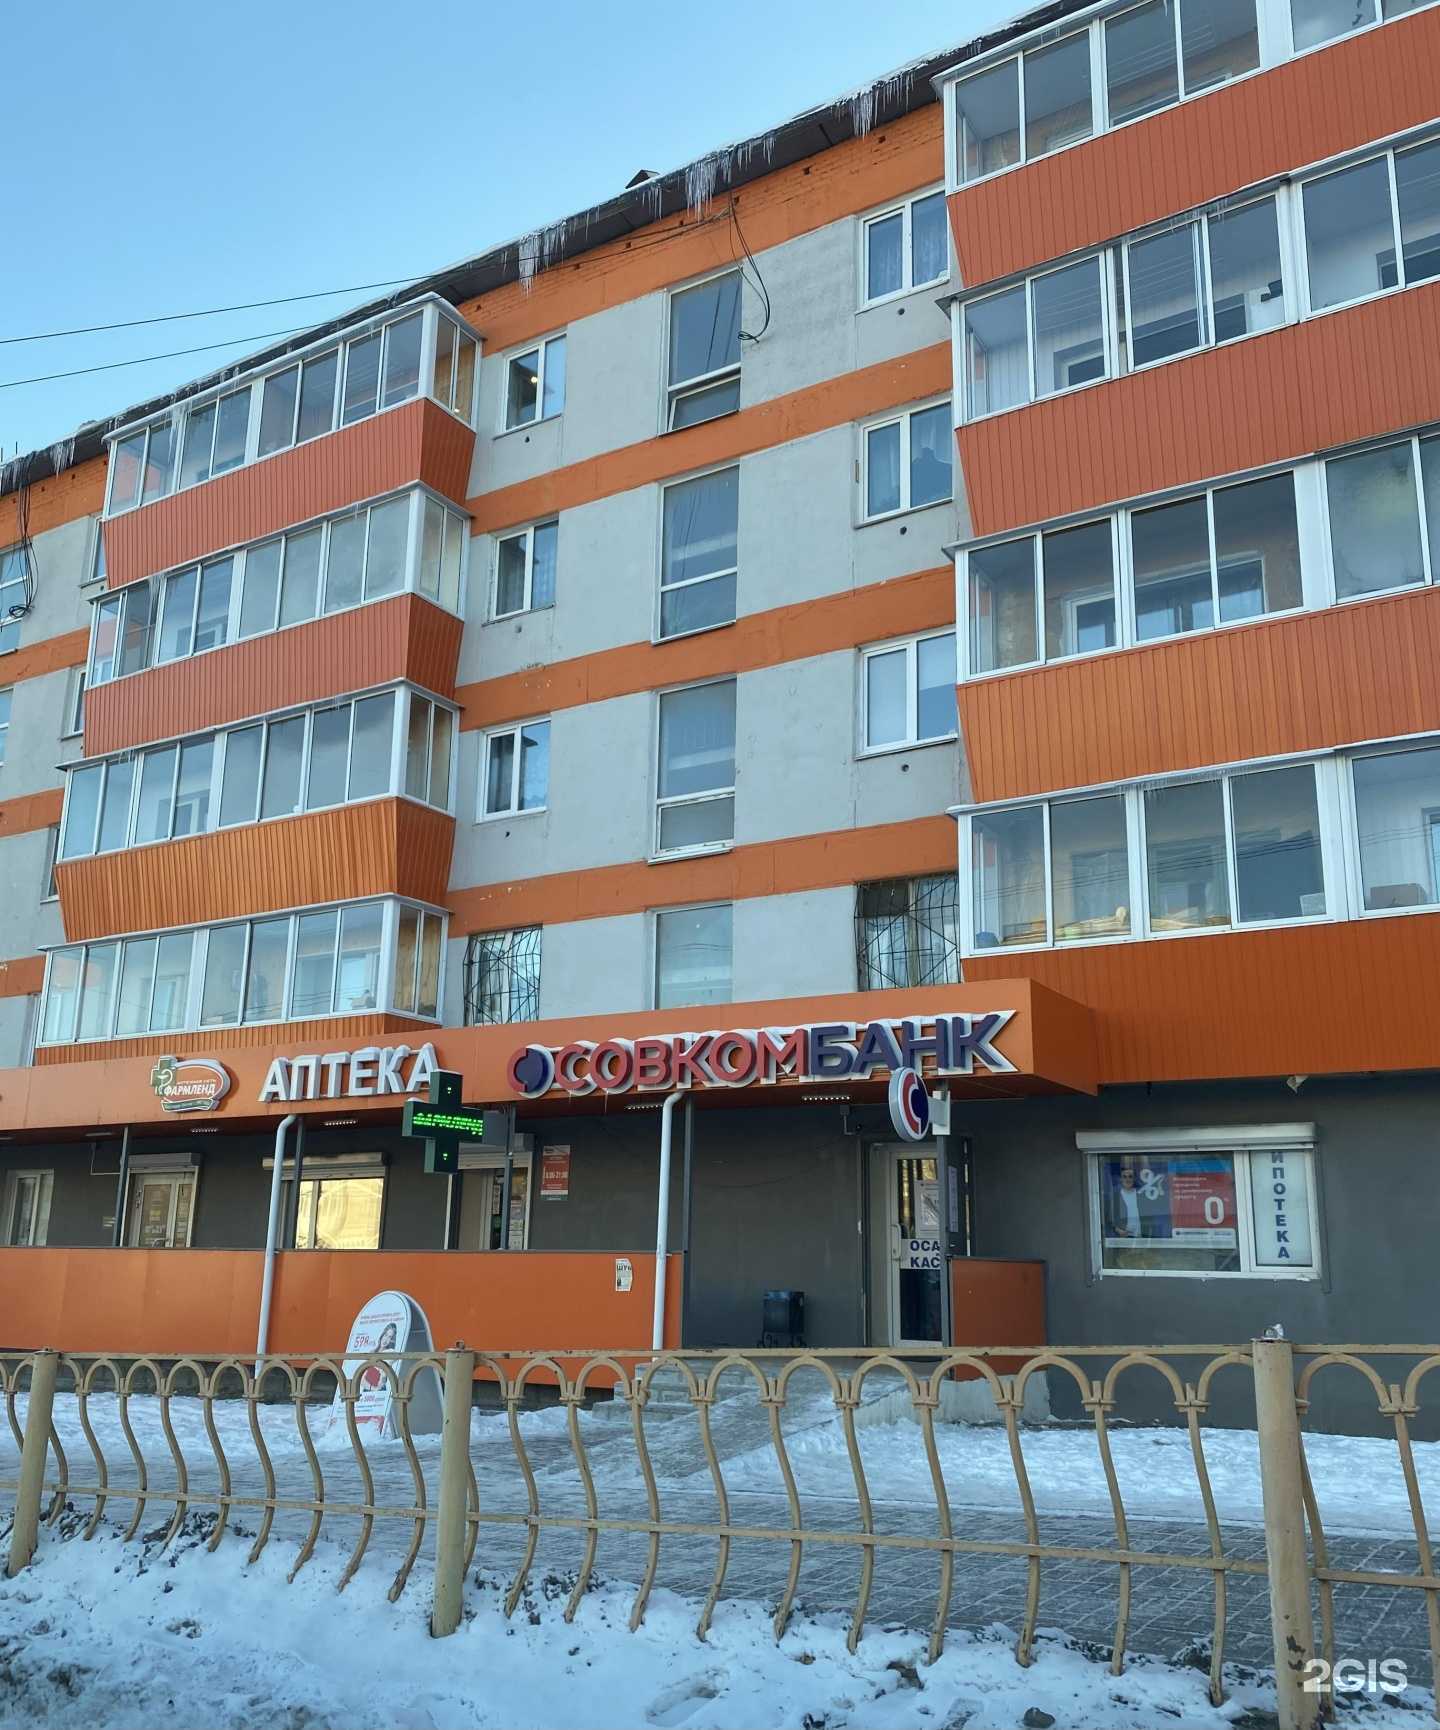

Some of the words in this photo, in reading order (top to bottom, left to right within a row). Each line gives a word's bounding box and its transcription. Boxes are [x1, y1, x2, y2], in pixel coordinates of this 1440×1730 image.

[554, 1011, 1014, 1094] СОВКОМБАНК
[162, 1083, 216, 1097] ФАРМЛЕНД
[258, 1043, 441, 1102] АПТЕКА
[1271, 1151, 1291, 1259] ИПОТЕКА
[910, 1240, 941, 1252] ОСА
[910, 1257, 941, 1269] КАС
